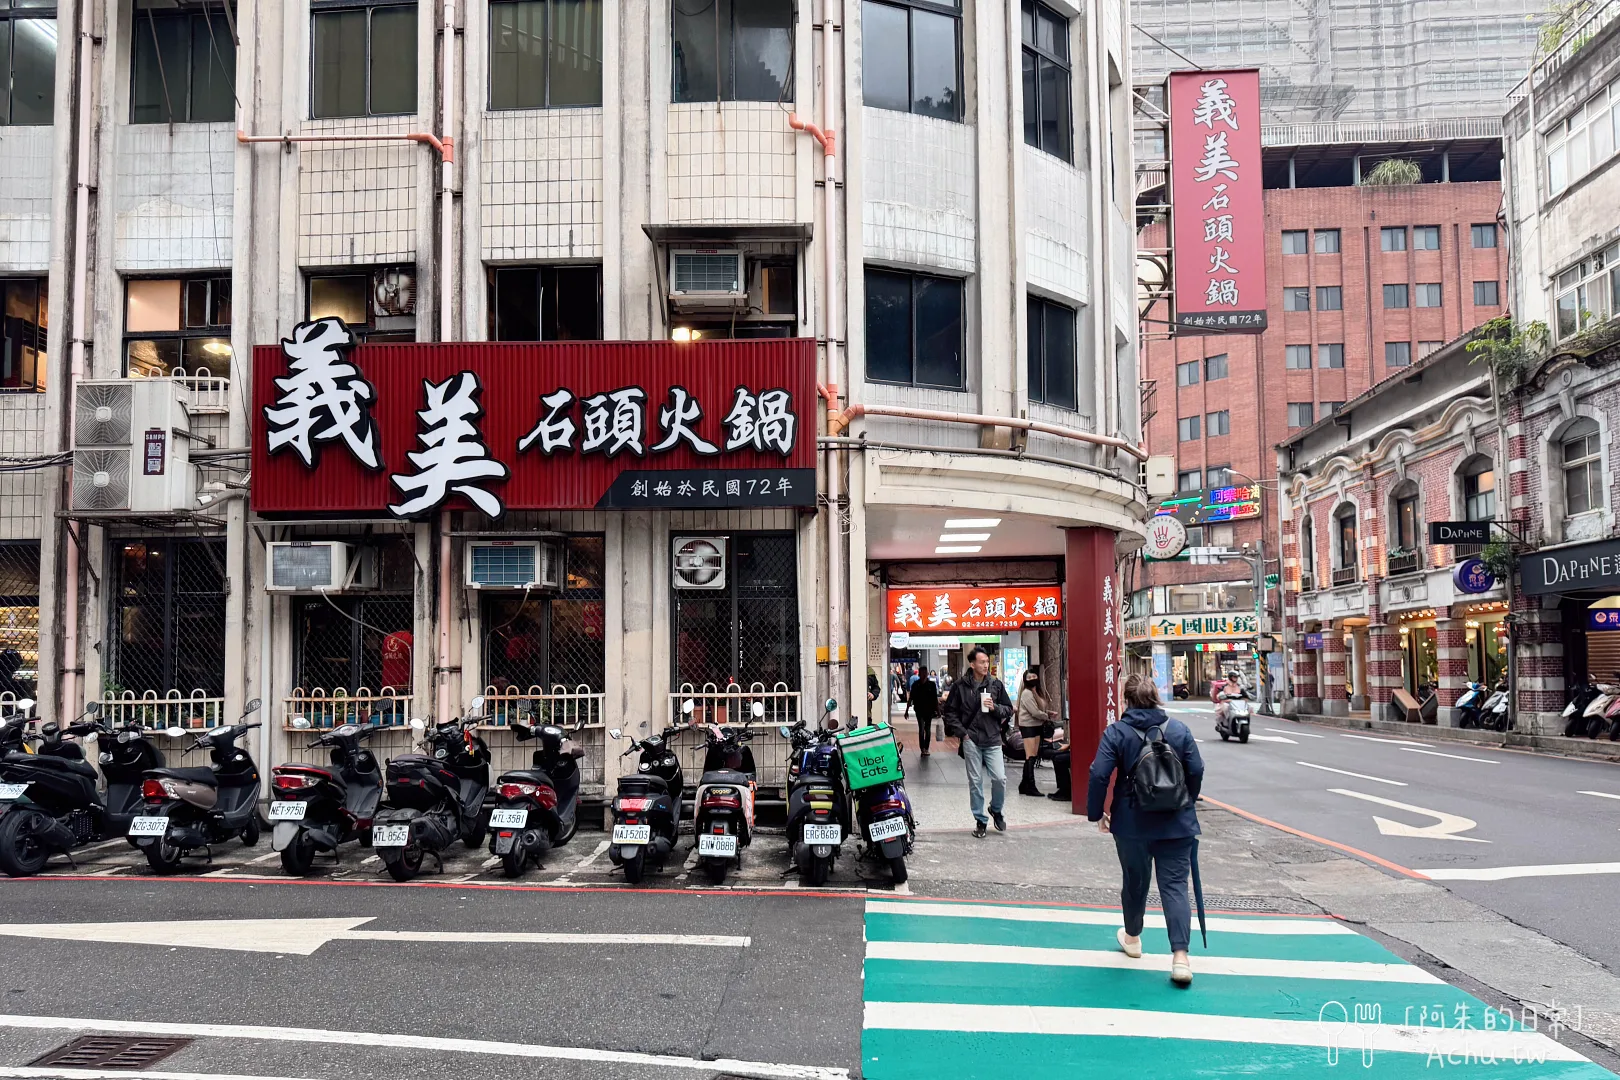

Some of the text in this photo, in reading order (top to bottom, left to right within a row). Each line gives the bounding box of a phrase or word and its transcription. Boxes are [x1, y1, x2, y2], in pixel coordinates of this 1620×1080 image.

[1192, 78, 1239, 307] 義美石頭火鍋
[630, 477, 793, 498] 創始於民國72年
[1439, 526, 1483, 540] DAPHNE
[1543, 556, 1612, 586] DAPHNE
[893, 592, 1059, 629] 義美石頭火鍋
[1157, 616, 1257, 636] 全國眼鏡
[857, 755, 885, 768] Uber
[861, 766, 889, 779] Eats
[270, 805, 304, 816] NET-9750
[491, 813, 525, 824] MTL-3581
[131, 821, 166, 831] NZG-3073
[871, 820, 904, 838] ERH-9800
[372, 831, 407, 842] MTL-8565
[614, 829, 649, 840] NAJ-5203
[805, 829, 839, 840] ERG-8689
